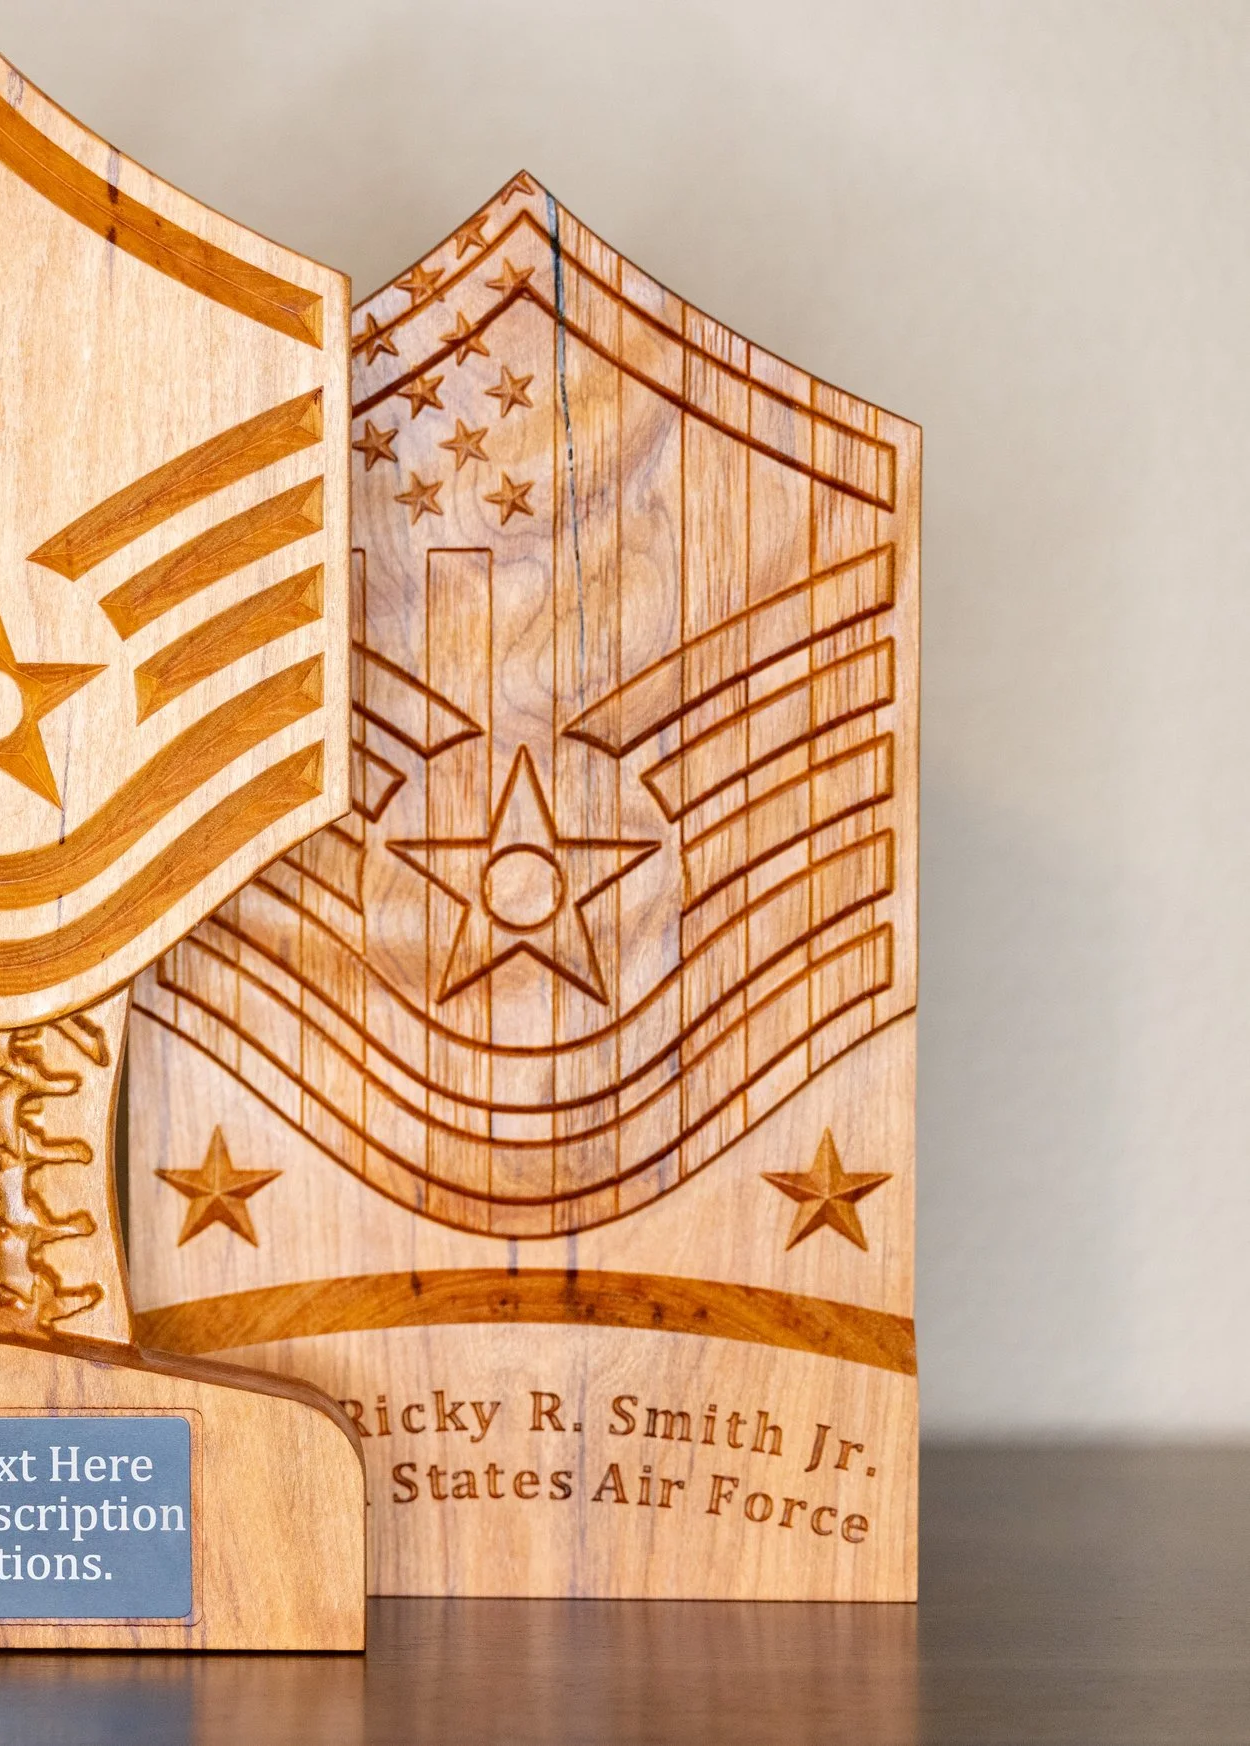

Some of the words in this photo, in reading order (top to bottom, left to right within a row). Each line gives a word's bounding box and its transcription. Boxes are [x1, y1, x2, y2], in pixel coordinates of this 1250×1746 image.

[49, 1446, 153, 1482] Here
[339, 1390, 501, 1443] Ricky
[529, 1391, 582, 1433] R.
[608, 1394, 783, 1457] Smith
[804, 1423, 876, 1477] Jr.
[391, 1461, 573, 1504] States
[591, 1462, 685, 1508] Air
[705, 1473, 869, 1544] Force
